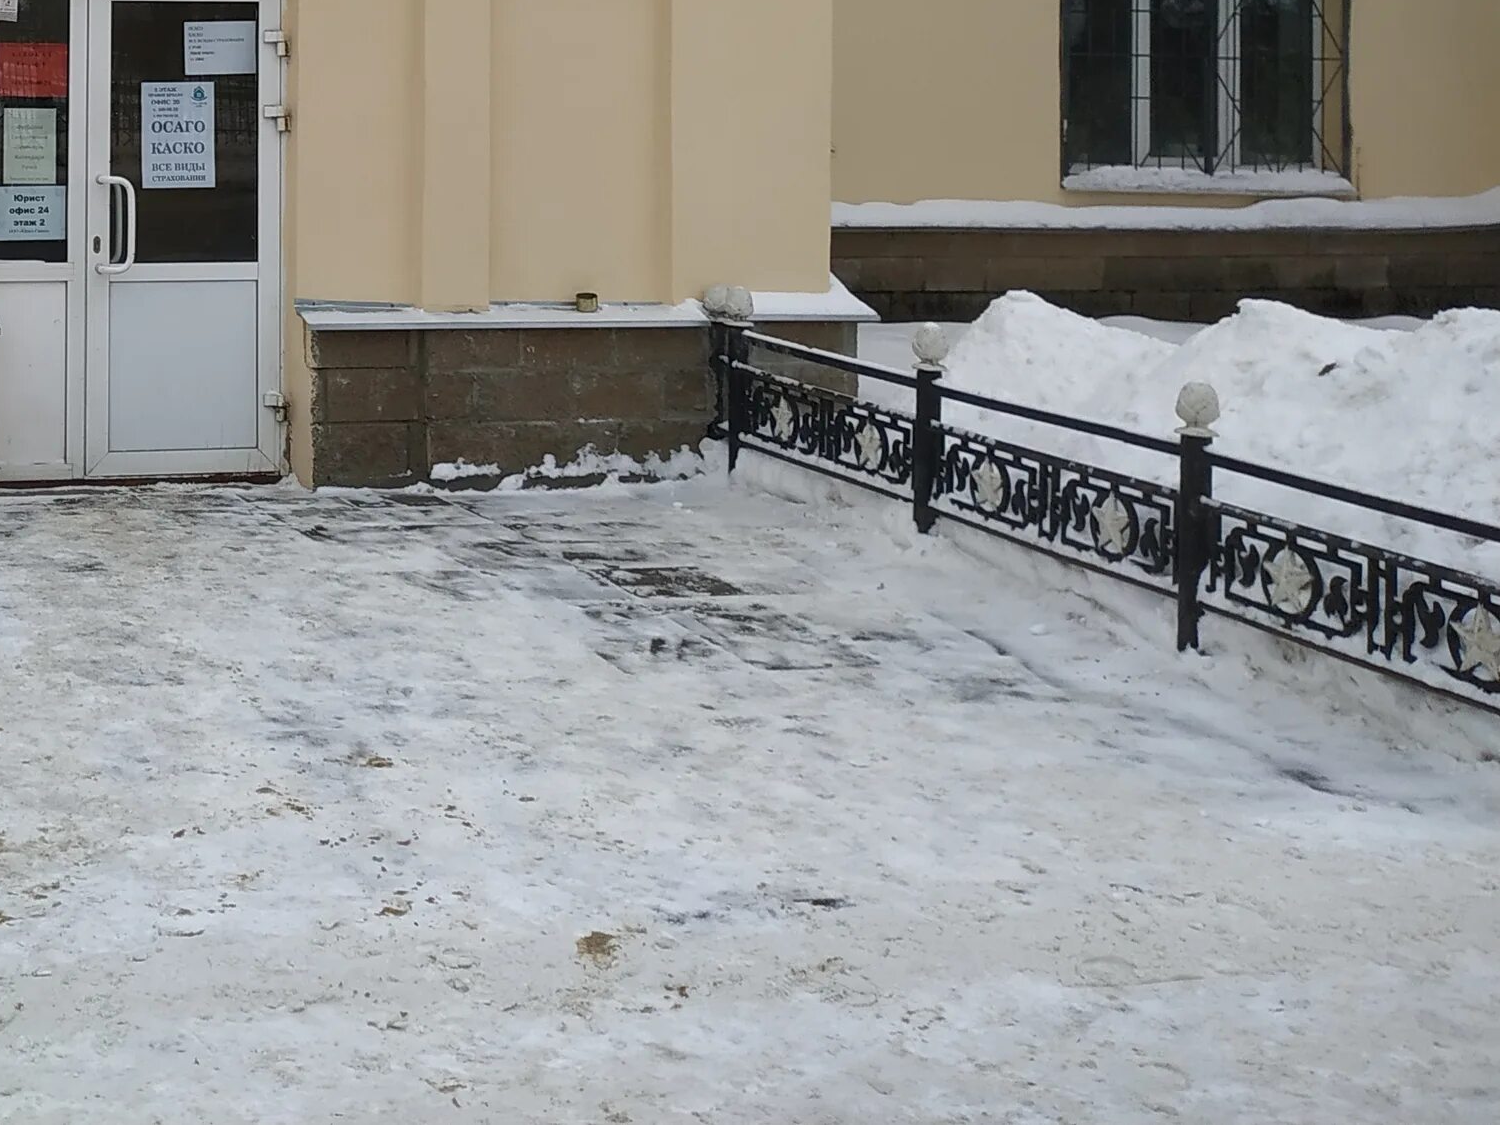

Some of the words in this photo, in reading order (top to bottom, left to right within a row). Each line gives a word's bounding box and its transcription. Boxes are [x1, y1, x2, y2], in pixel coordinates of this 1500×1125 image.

[151, 120, 206, 134] ОСАГО
[151, 141, 206, 155] КАСКО
[151, 163, 173, 172] ВСЕ
[174, 163, 206, 173] ВИДЫ
[151, 174, 207, 182] СТРАХОВАНИЯ
[13, 194, 46, 204] Юрист
[9, 206, 35, 216] офис
[37, 206, 50, 214] 24
[39, 218, 46, 226] 2
